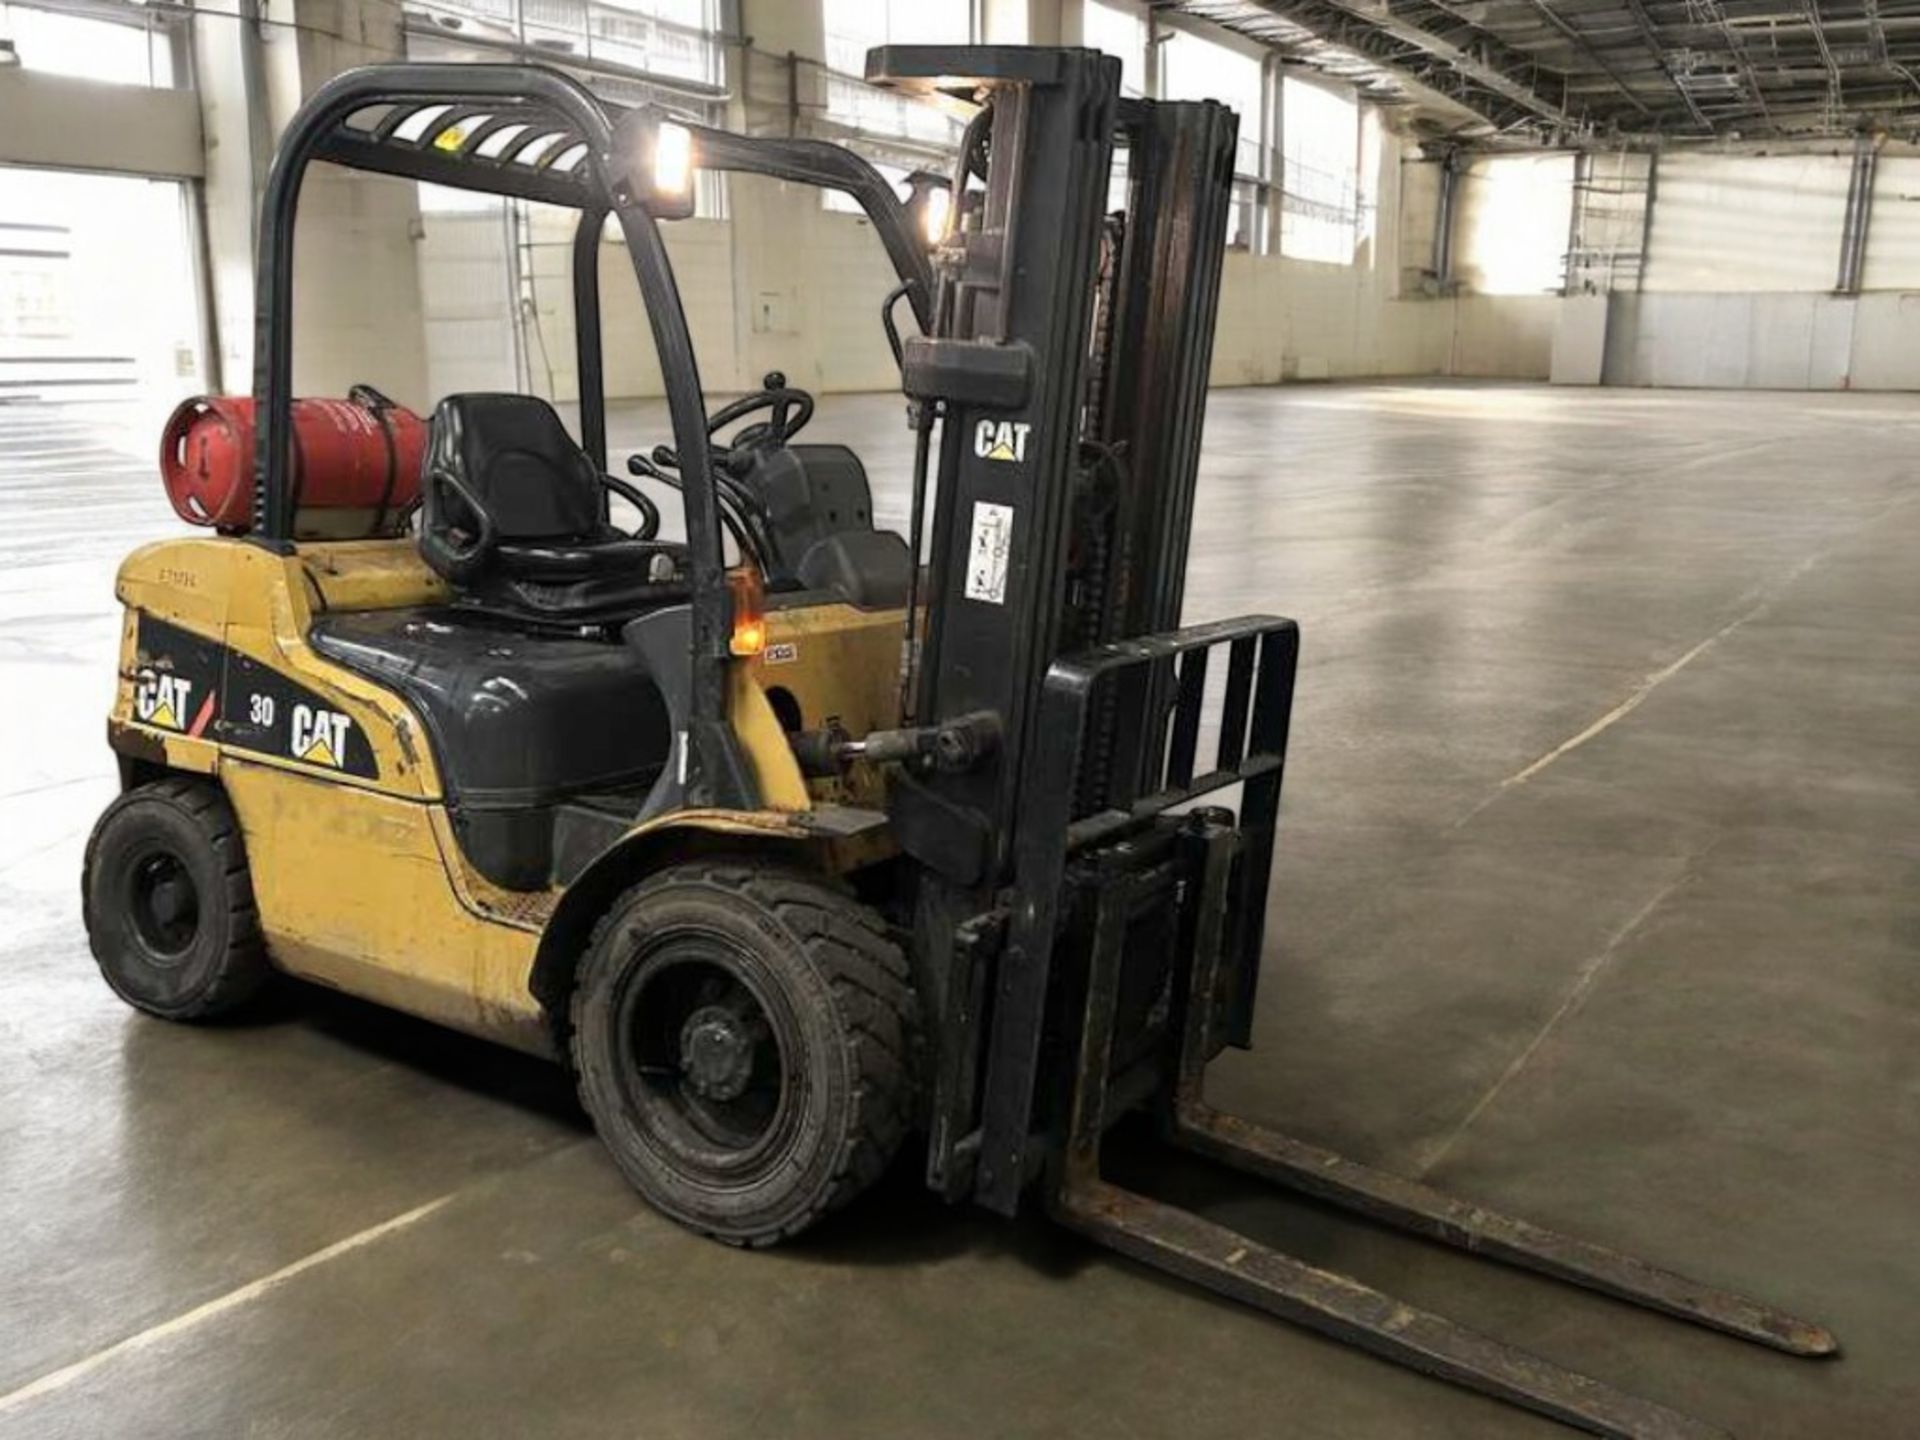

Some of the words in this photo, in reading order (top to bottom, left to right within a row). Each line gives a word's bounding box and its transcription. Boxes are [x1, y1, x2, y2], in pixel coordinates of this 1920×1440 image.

[974, 419, 1031, 462] CAT
[138, 669, 191, 730] CAT
[249, 694, 274, 727] 30
[291, 703, 351, 768] CAT
